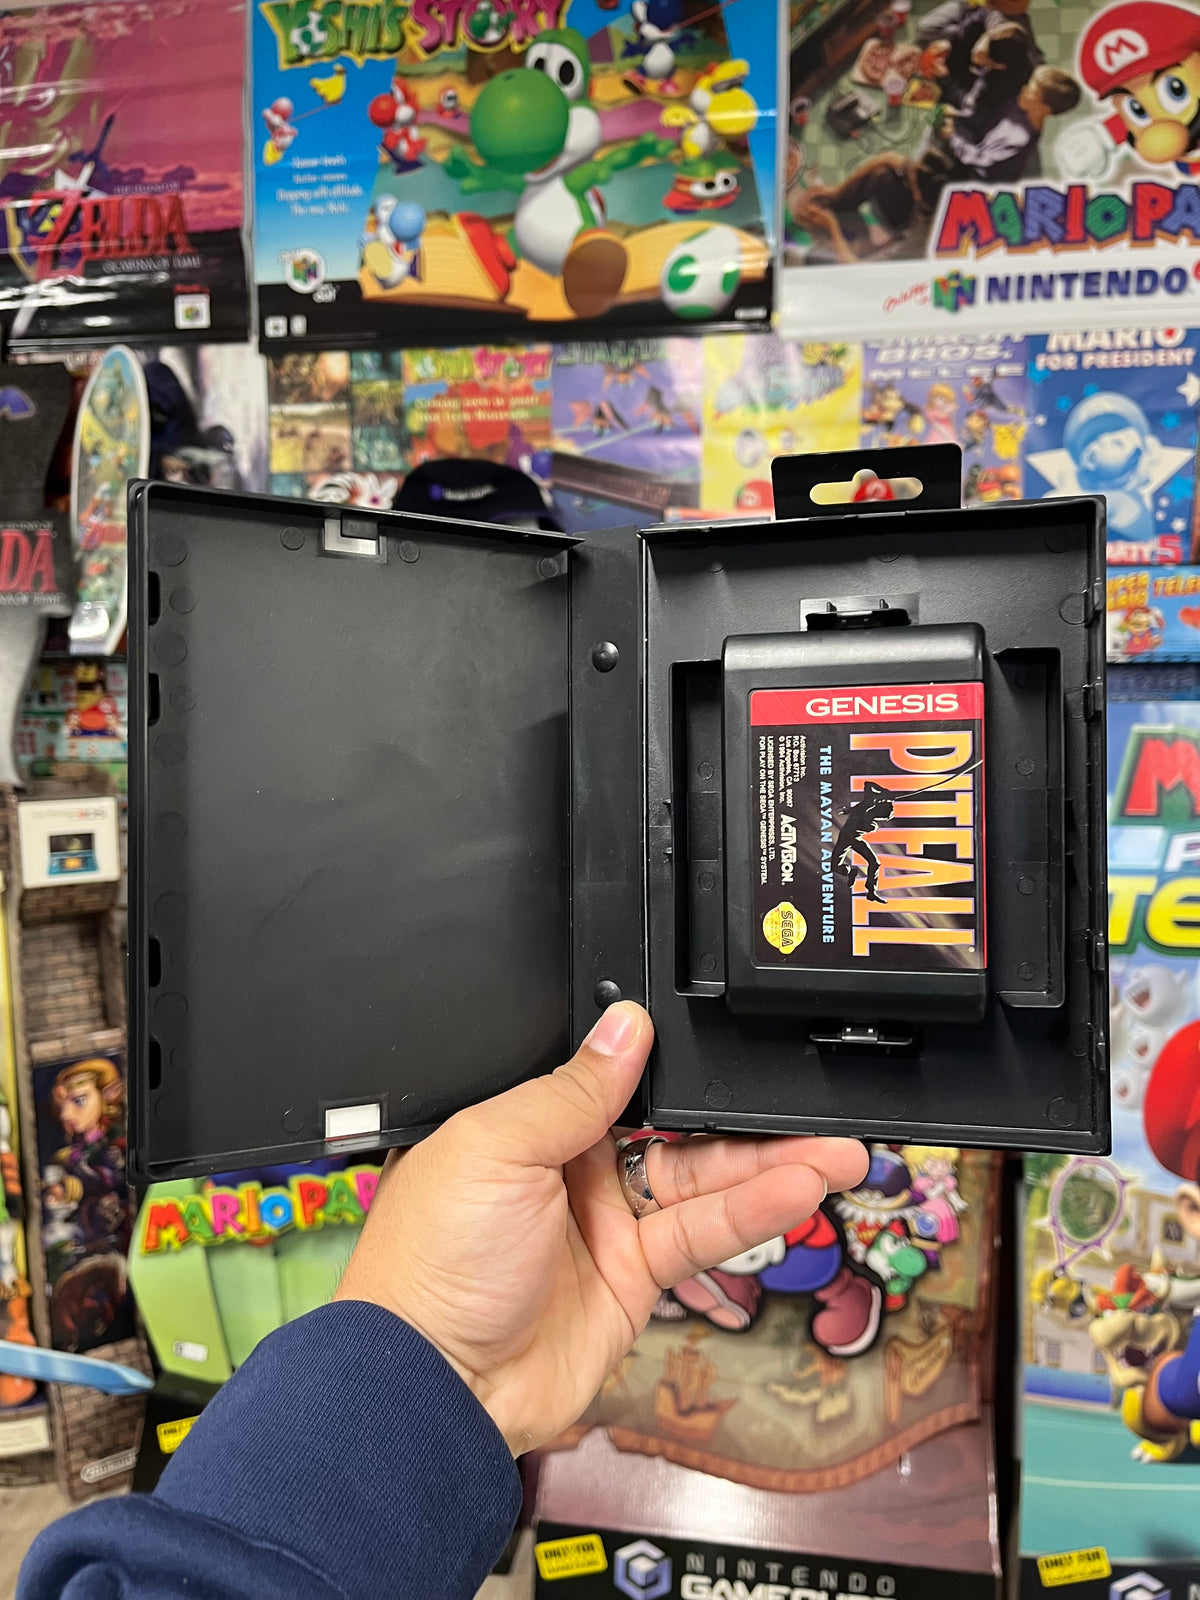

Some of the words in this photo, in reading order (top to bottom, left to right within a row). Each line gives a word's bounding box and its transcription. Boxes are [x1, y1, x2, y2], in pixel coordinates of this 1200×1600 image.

[936, 184, 1128, 253] MARIO
[987, 268, 1188, 303] NINTENDO
[805, 692, 960, 717] GENESIS
[759, 751, 767, 769] PLAY
[760, 769, 767, 779] ON
[767, 769, 775, 779] BY
[819, 745, 832, 775] THE
[785, 776, 793, 786] CA
[819, 781, 833, 843] MAYAN
[849, 730, 976, 957] PITFALL
[820, 848, 835, 944] ADVENTURE
[780, 910, 794, 947] SEGA
[144, 1185, 294, 1251] MARIO
[681, 1573, 898, 1600] GAME
[686, 1552, 895, 1596] NINTENDO
